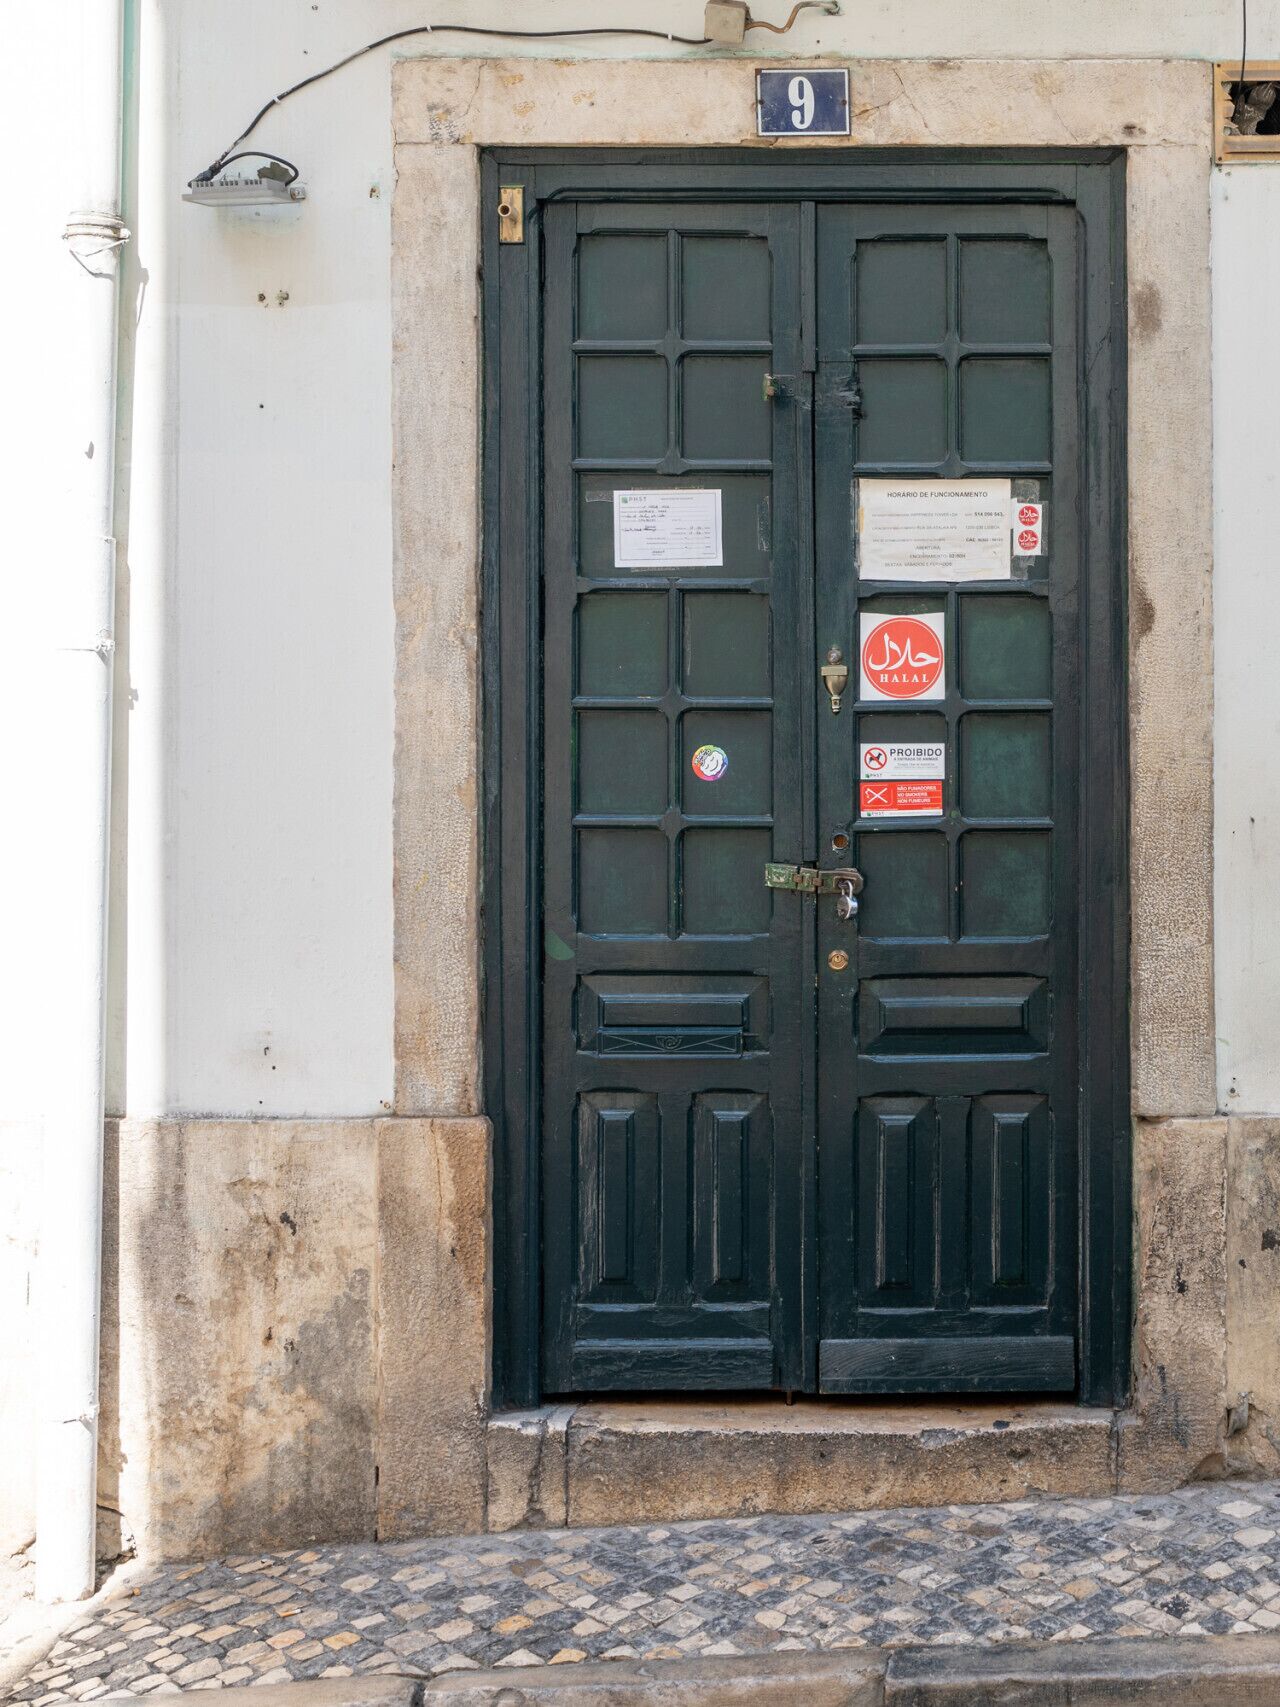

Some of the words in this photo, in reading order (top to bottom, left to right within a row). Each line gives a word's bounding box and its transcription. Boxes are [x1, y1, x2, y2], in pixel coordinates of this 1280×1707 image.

[788, 76, 814, 129] 9
[869, 632, 939, 670] حلال
[880, 673, 928, 682] HALAL
[889, 748, 942, 757] PROIBIDO
